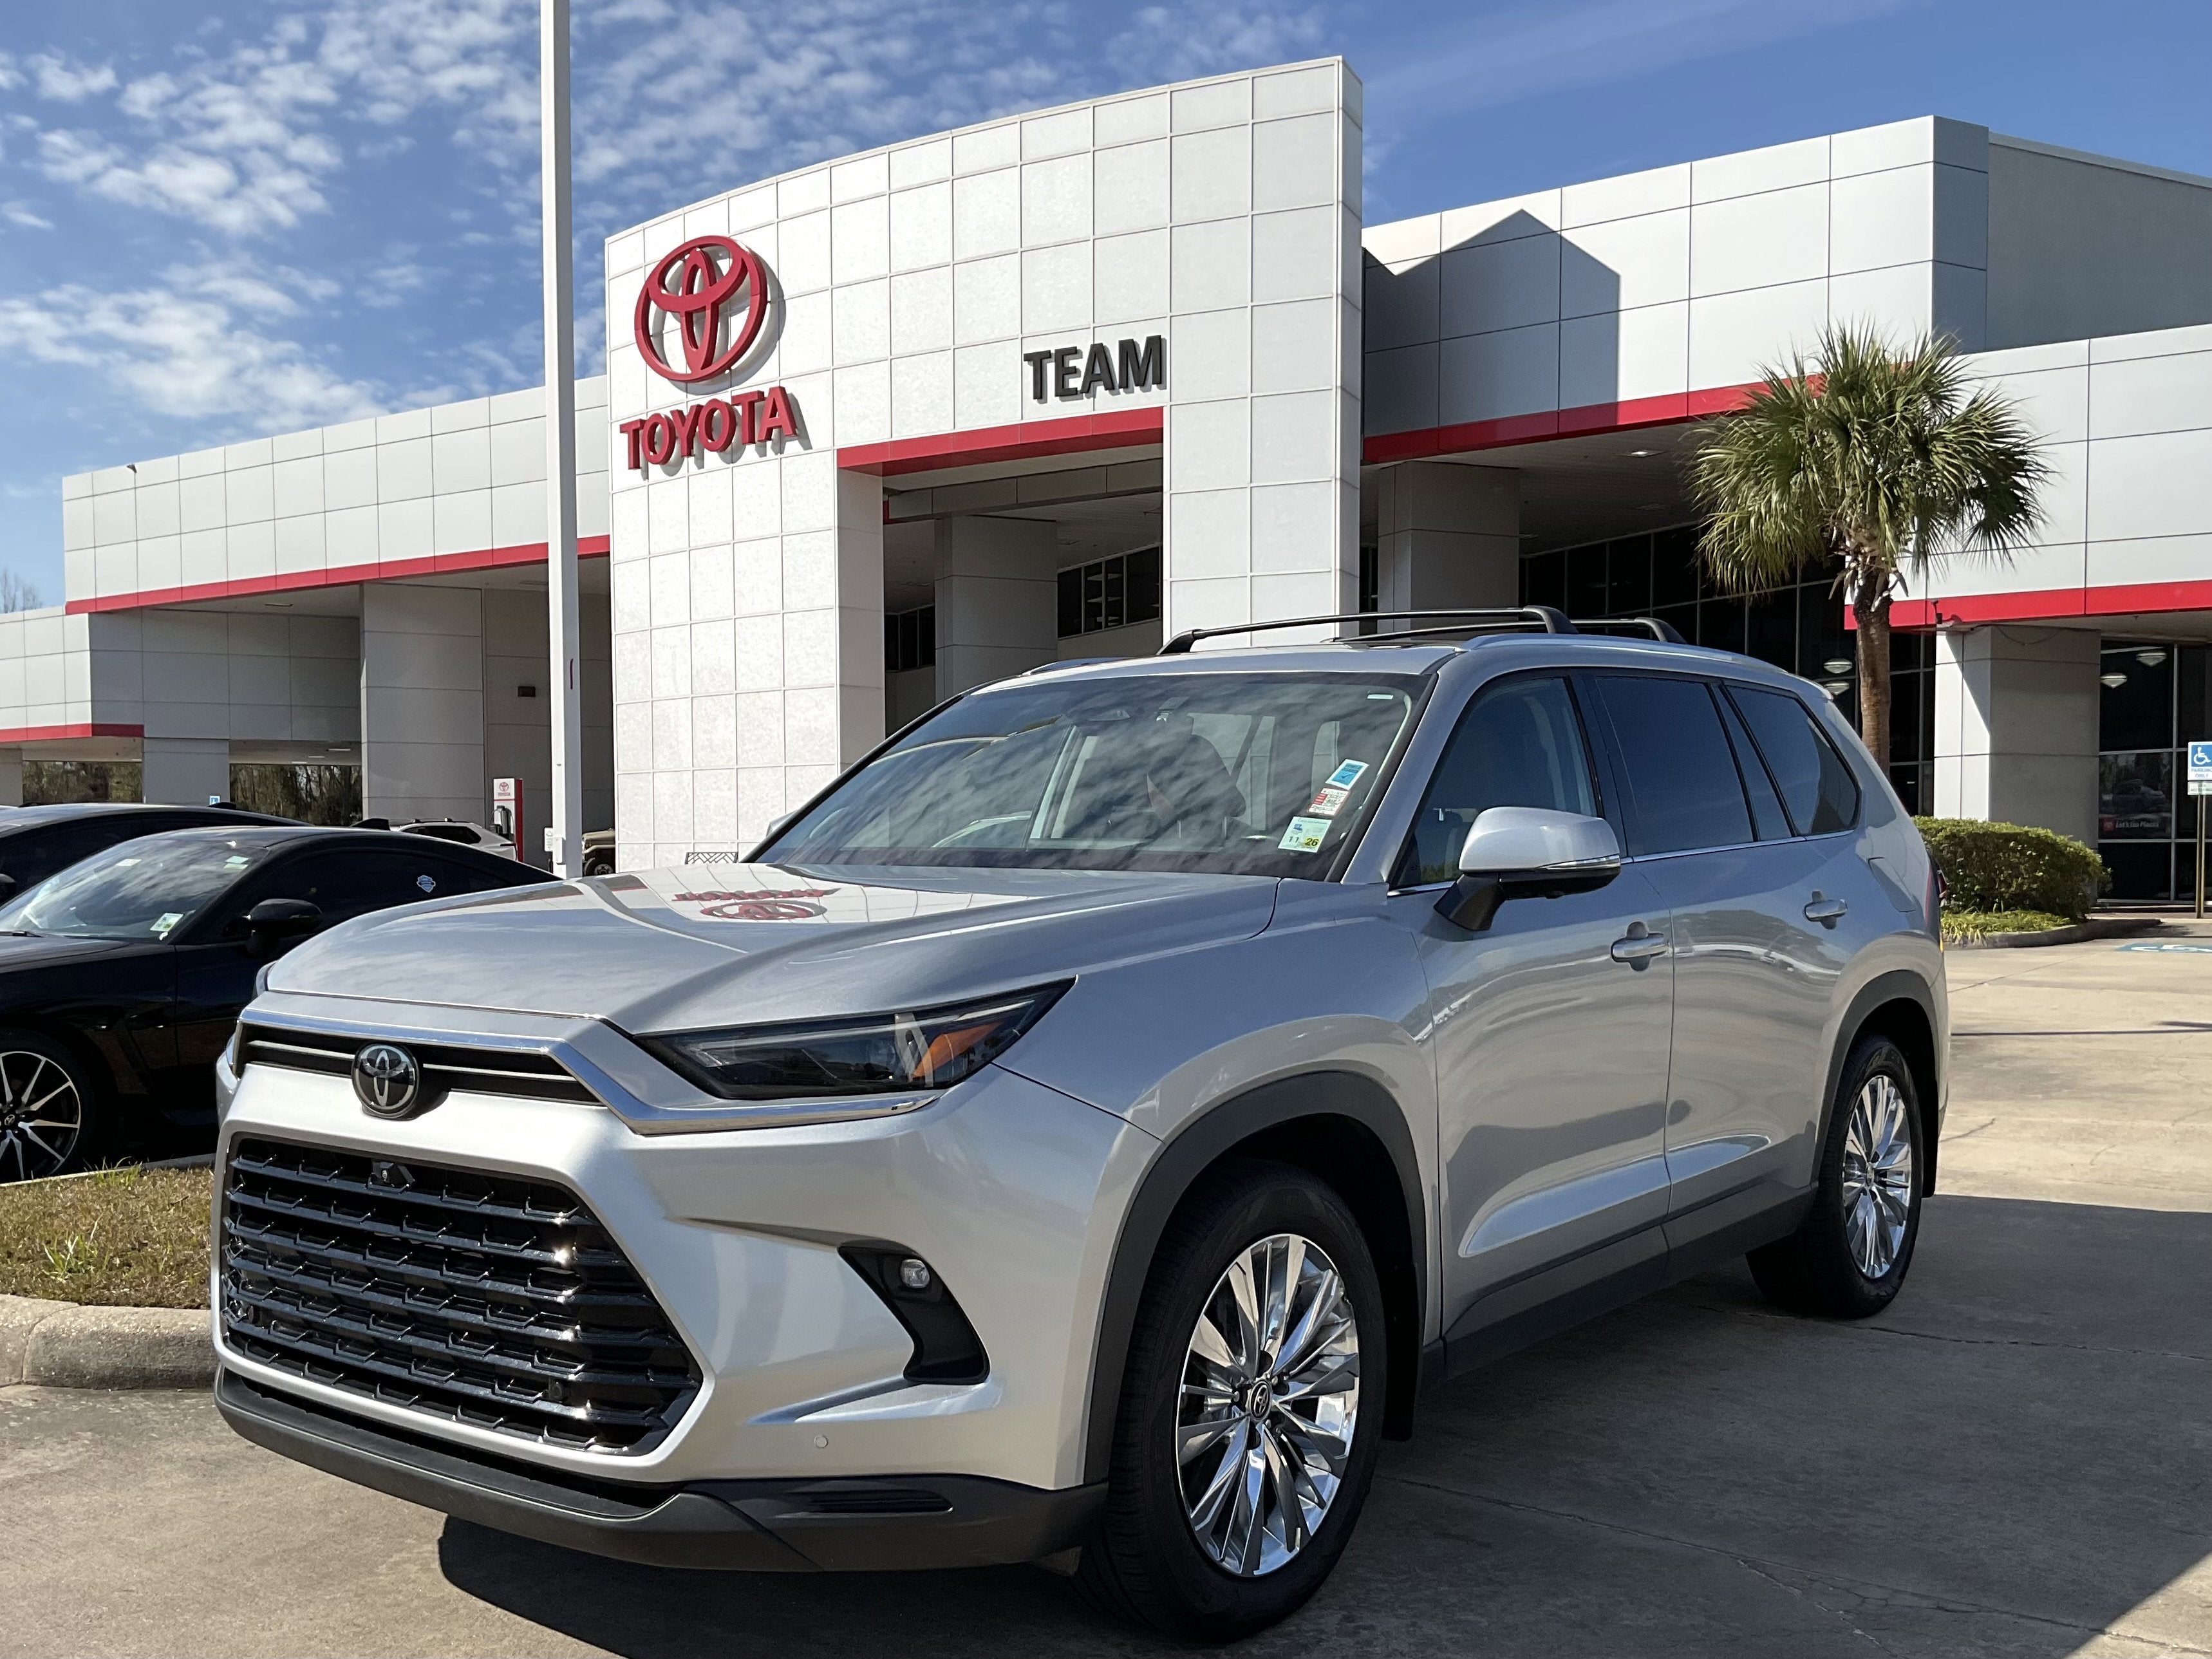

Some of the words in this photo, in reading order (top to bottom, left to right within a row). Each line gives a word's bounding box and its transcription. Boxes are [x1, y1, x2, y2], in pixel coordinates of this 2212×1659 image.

[1024, 335, 1163, 400] TEAM
[619, 386, 800, 470] TOYOTA
[1305, 838, 1319, 846] 26
